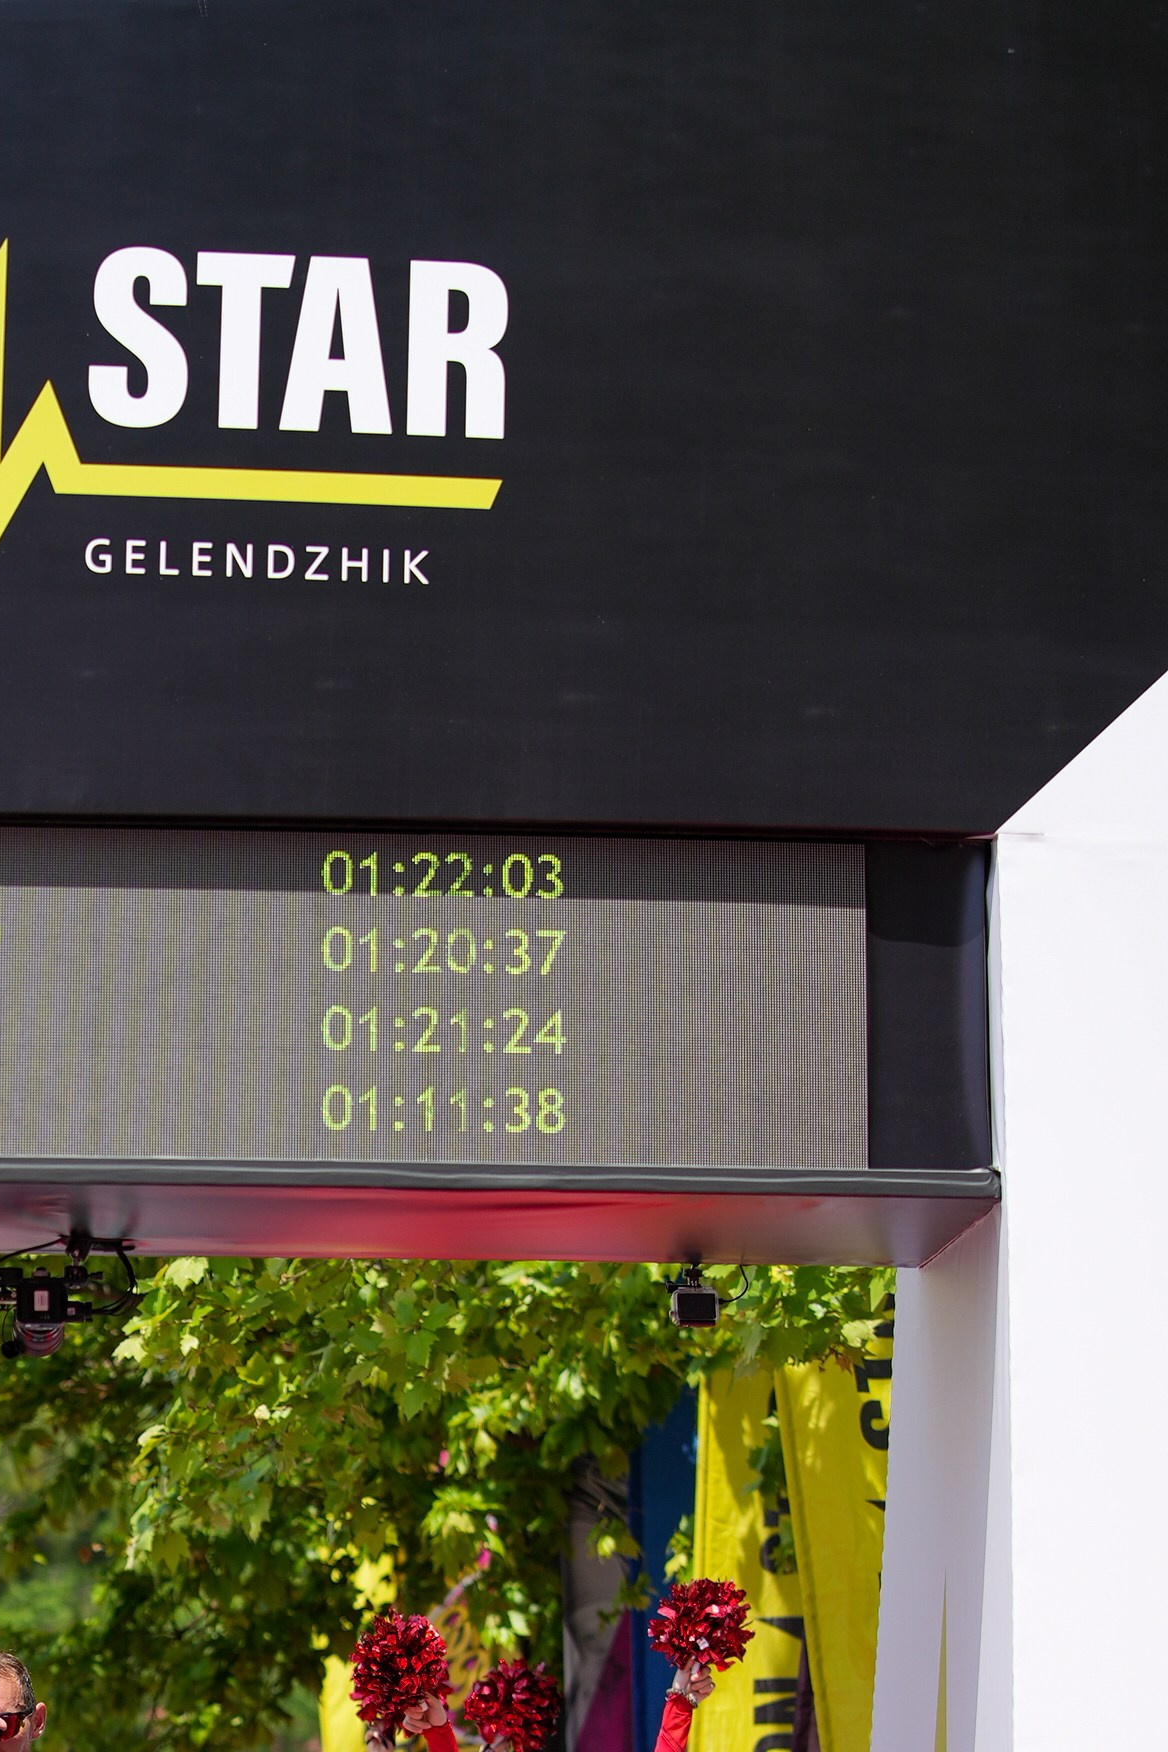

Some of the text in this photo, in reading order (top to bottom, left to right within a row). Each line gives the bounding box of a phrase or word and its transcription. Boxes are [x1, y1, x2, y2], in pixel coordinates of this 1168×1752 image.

[88, 246, 509, 439] STAR
[85, 538, 431, 585] GELENDZHIK
[321, 850, 565, 899] 01:22:03
[321, 926, 566, 976] 01:20:37
[321, 1005, 568, 1055] 01:21:24
[321, 1085, 567, 1134] 01:11:38
